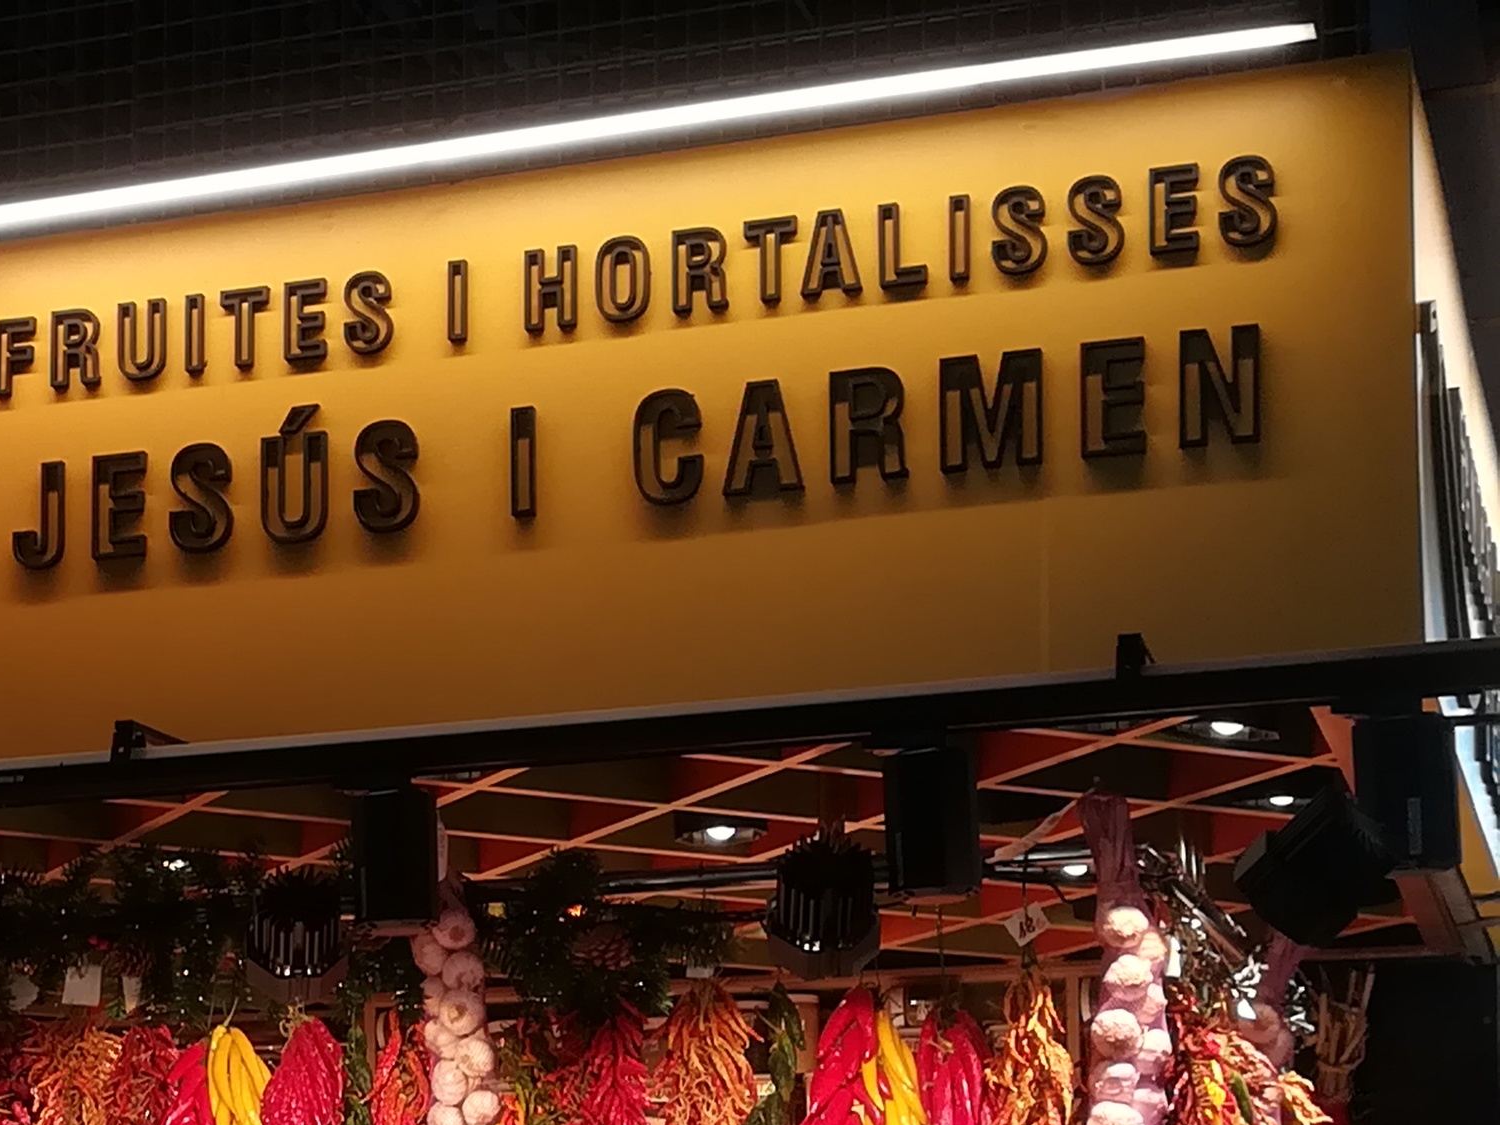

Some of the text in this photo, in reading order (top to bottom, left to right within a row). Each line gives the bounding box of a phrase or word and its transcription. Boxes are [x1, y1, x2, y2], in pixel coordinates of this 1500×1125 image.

[446, 258, 469, 343] I
[523, 155, 1278, 334] HORTALISSES
[12, 323, 1261, 571] JESÚS I CARMEN
